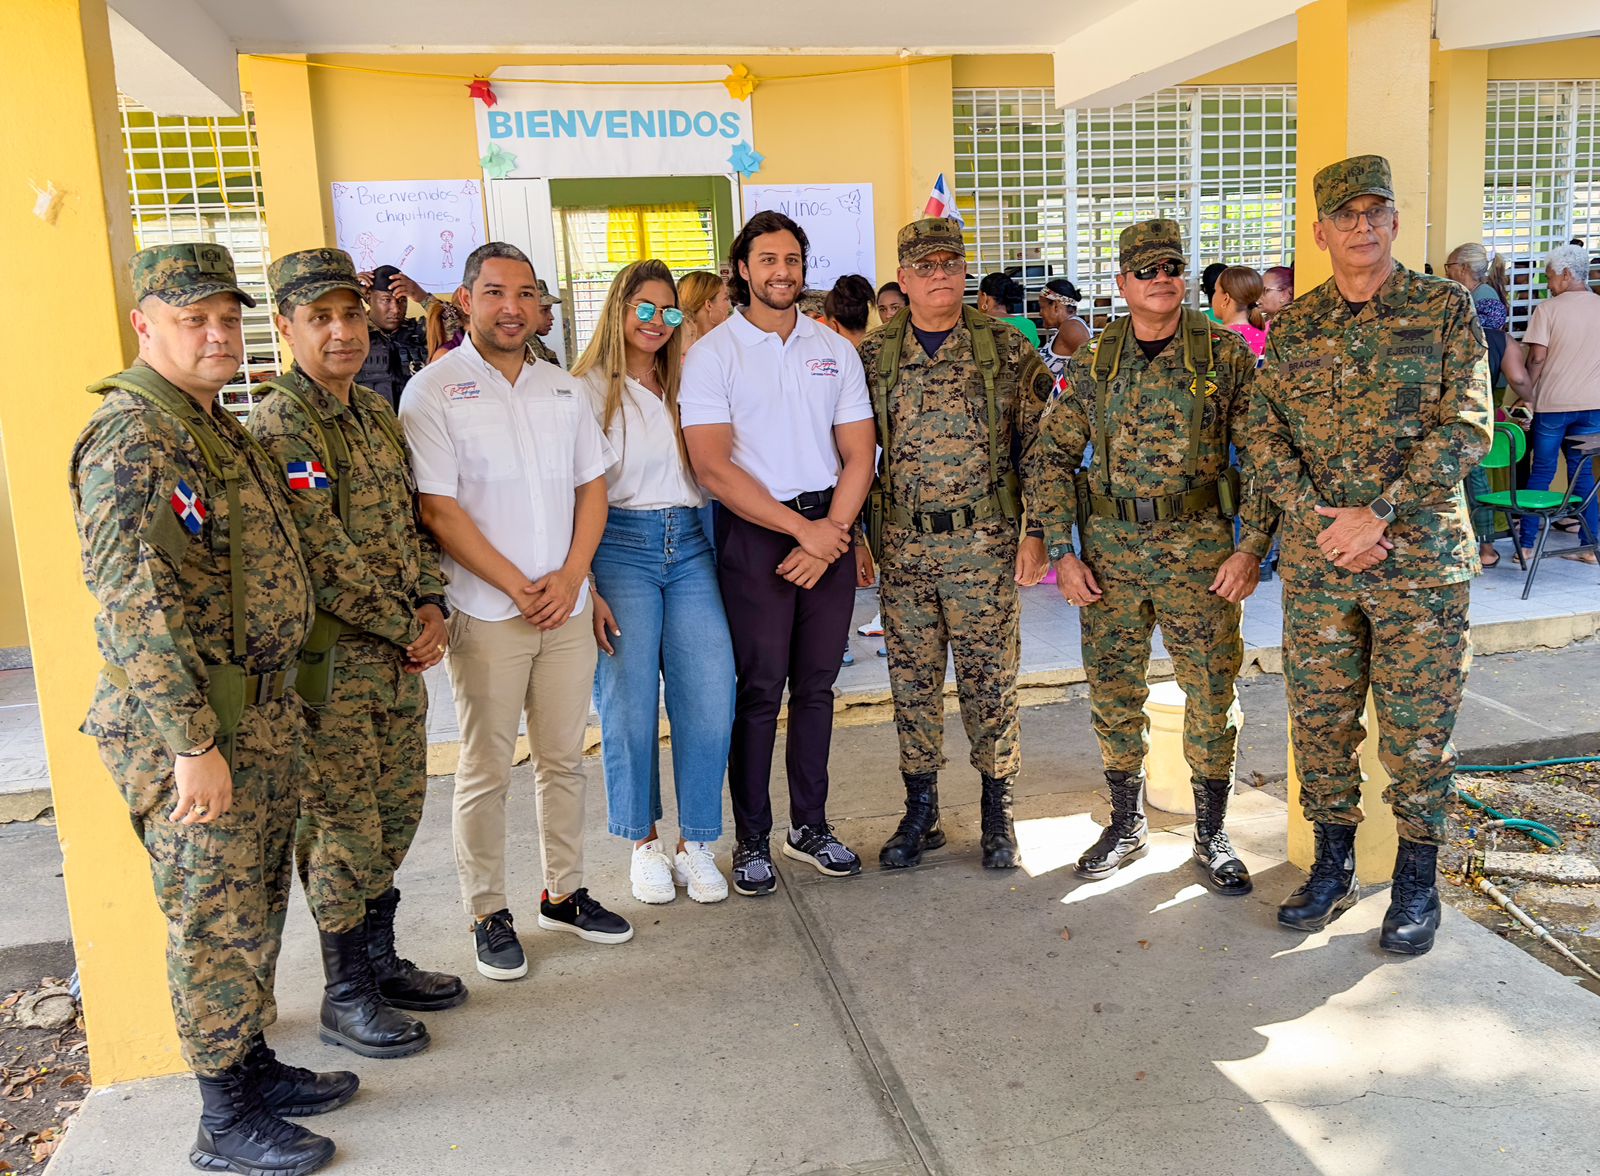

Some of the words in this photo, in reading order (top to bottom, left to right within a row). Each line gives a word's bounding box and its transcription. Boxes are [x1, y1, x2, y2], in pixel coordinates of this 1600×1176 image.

[487, 110, 740, 139] BIENVENIDOS
[357, 185, 459, 205] Bienvenidos
[1386, 345, 1433, 356] EJERCITO
[1288, 359, 1321, 372] BRACHE
